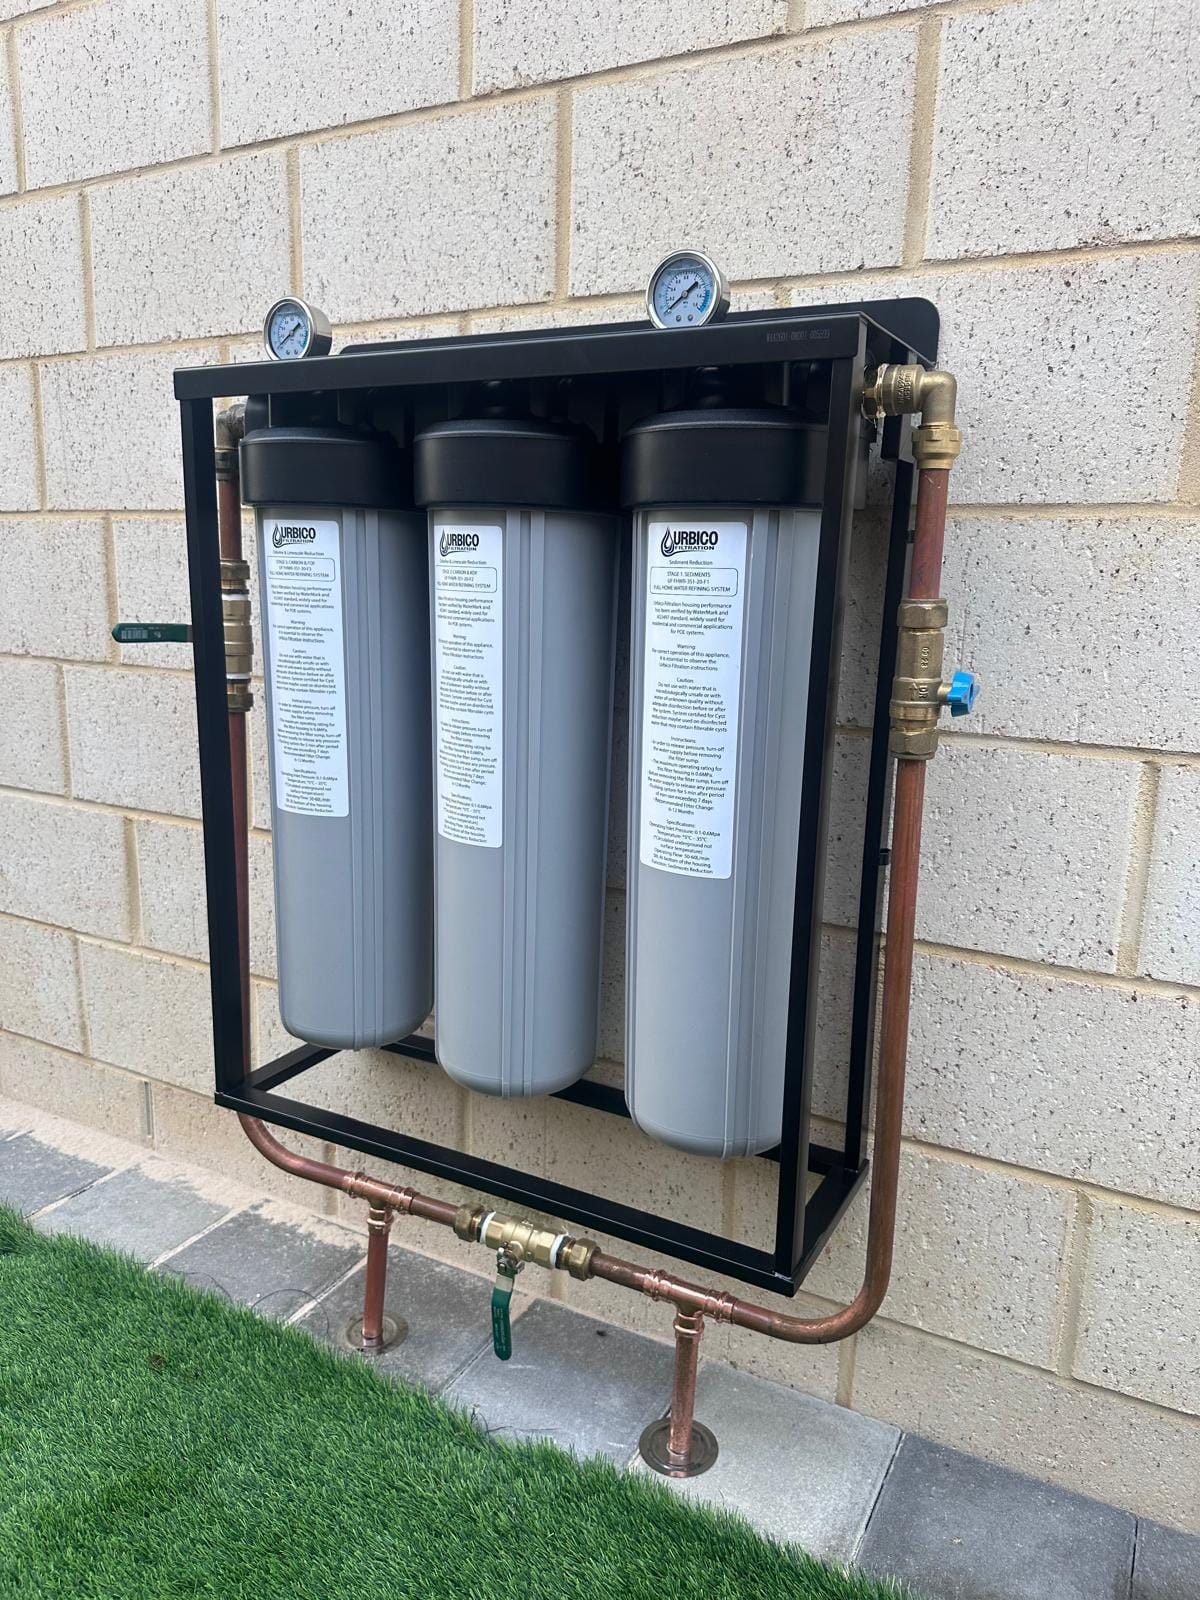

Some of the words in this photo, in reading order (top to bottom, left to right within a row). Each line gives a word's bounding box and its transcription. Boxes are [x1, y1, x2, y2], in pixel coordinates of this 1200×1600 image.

[281, 527, 316, 539] URBICO
[674, 531, 718, 545] URBICO
[447, 534, 479, 546] URBICO
